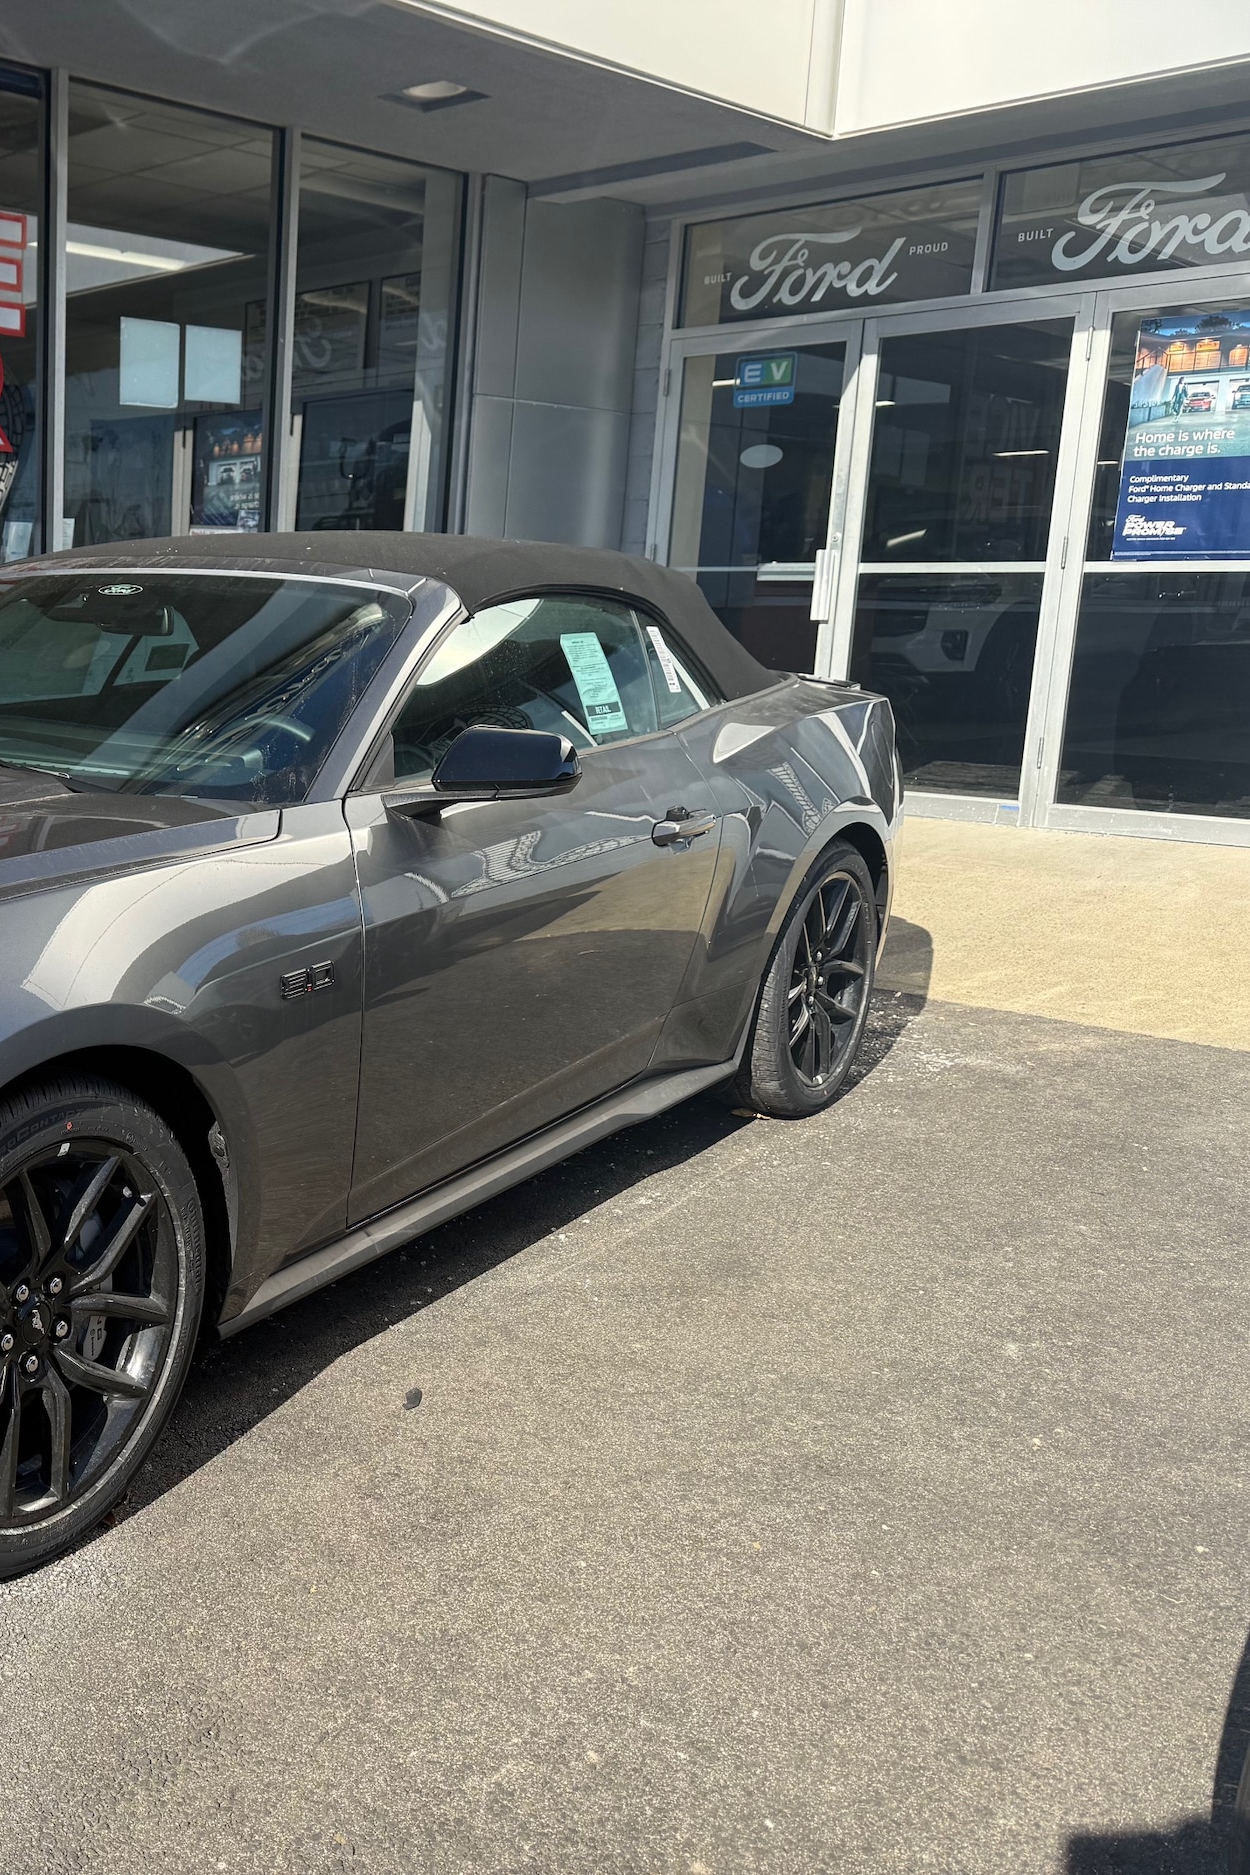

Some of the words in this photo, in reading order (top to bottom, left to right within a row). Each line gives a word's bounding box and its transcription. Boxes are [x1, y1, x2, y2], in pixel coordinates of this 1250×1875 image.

[1017, 228, 1054, 243] BUILT
[704, 272, 732, 285] BUILT
[730, 226, 907, 311] Ford
[909, 242, 949, 256] PROUD
[737, 391, 790, 404] CERTIFIED
[1135, 432, 1174, 443] Home
[1178, 430, 1189, 442] is
[1192, 428, 1235, 440] where
[1133, 445, 1155, 457] the
[1158, 444, 1203, 457] charge
[1207, 442, 1221, 453] is.
[1129, 474, 1189, 484] Complimentary
[1150, 482, 1173, 492] Home
[1175, 481, 1205, 492] Charger
[1207, 482, 1222, 490] and
[1127, 494, 1157, 504] Charger
[1159, 493, 1202, 502] Installation
